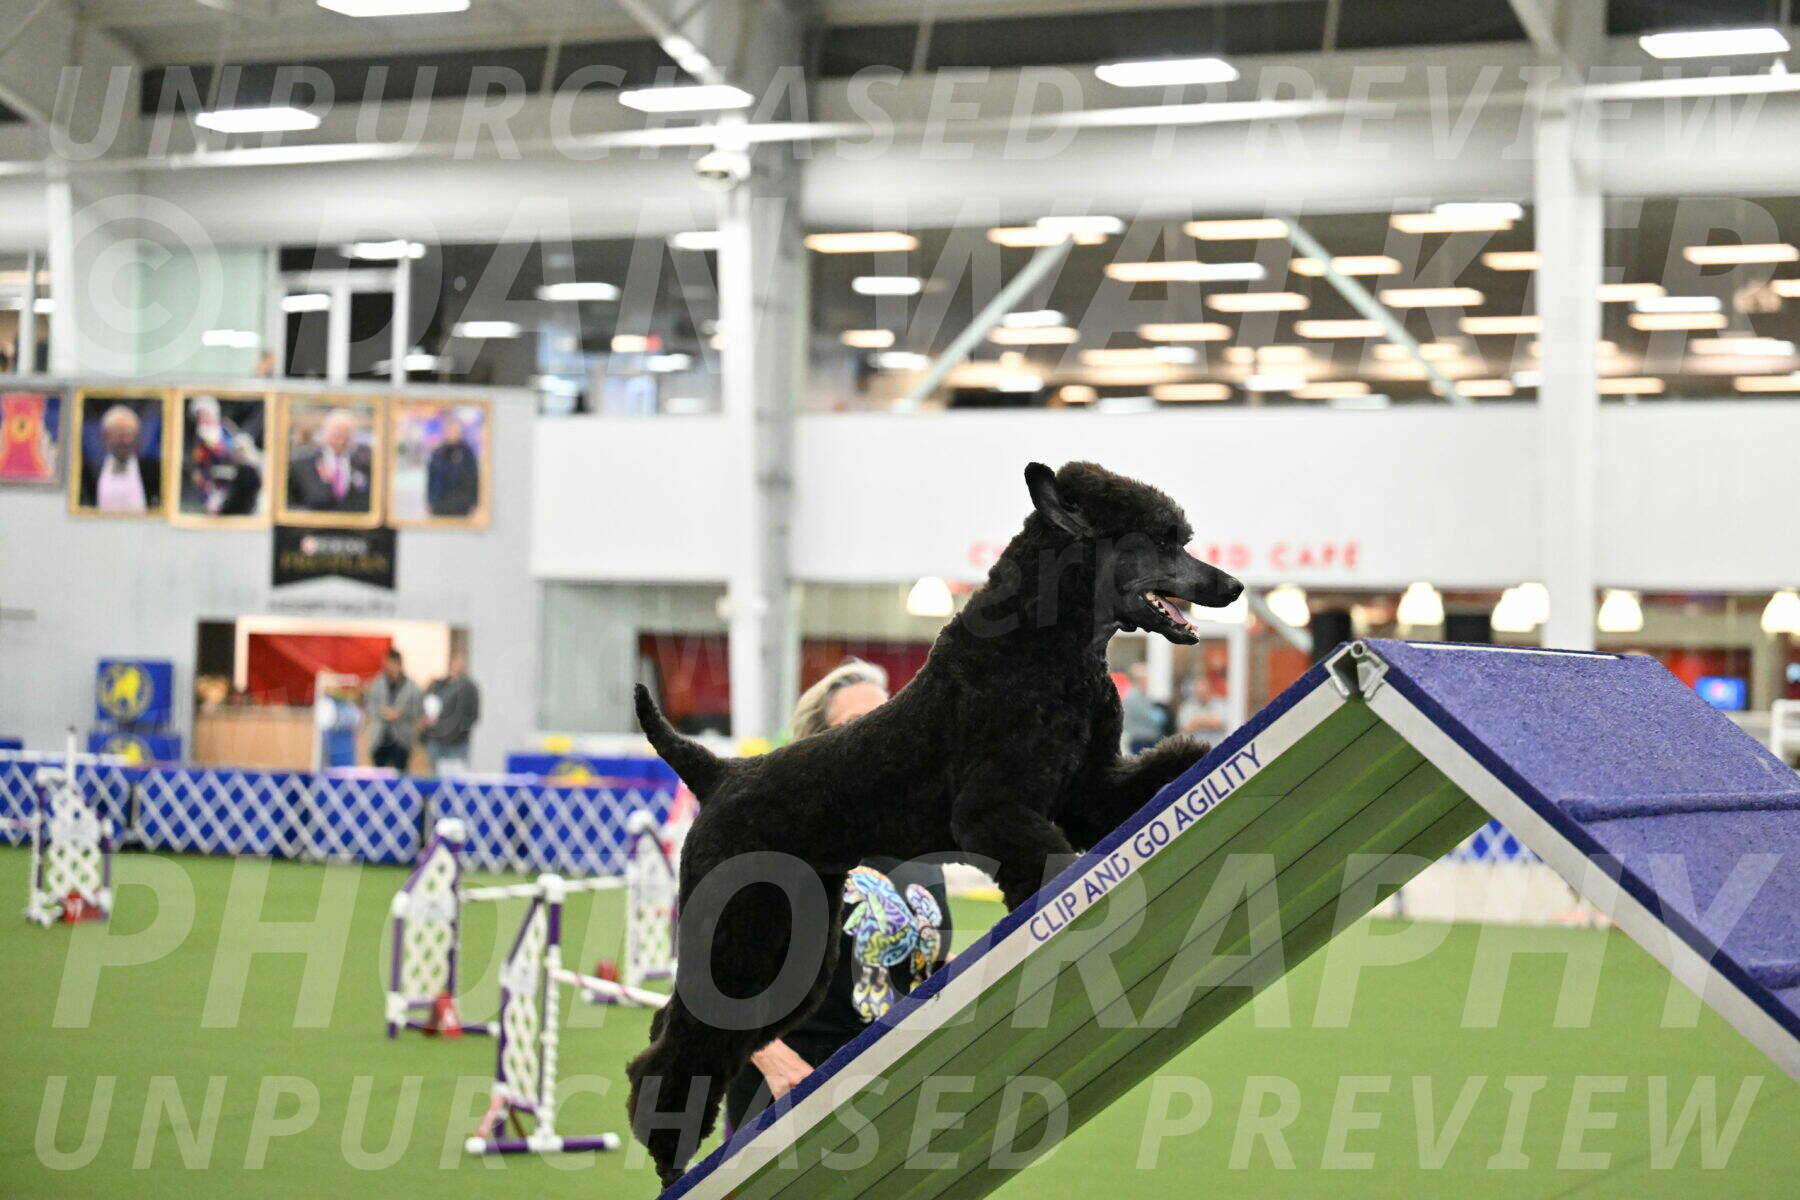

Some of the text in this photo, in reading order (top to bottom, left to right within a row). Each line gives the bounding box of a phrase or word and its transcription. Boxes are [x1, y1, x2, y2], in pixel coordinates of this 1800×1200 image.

[1030, 742, 1262, 941] CLIP AND GO AGILITY
